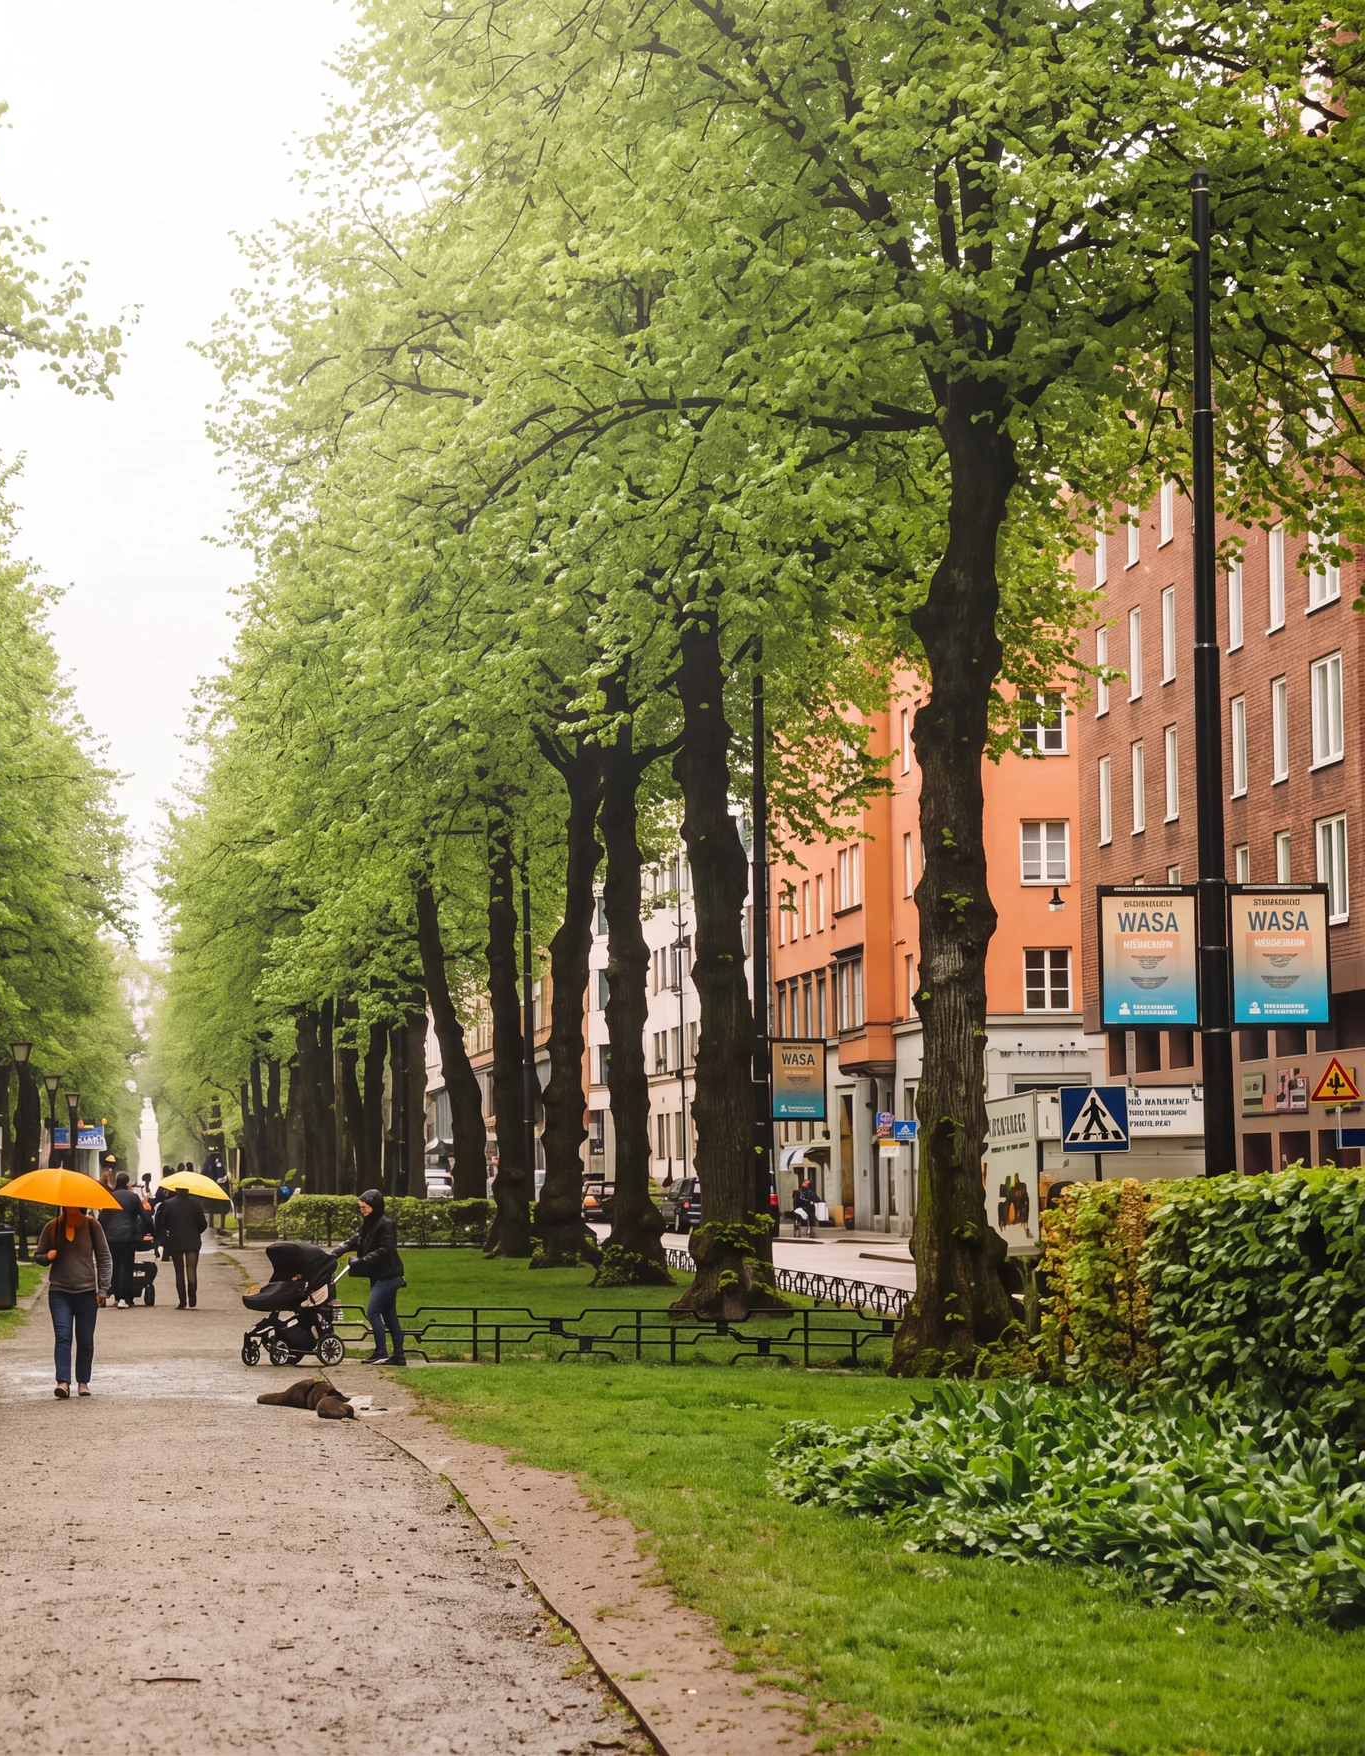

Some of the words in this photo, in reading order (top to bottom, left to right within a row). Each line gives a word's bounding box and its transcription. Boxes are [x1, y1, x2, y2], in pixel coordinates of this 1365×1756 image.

[1117, 911, 1179, 933] WASA
[1247, 910, 1310, 931] WASA
[781, 1053, 816, 1066] WASA
